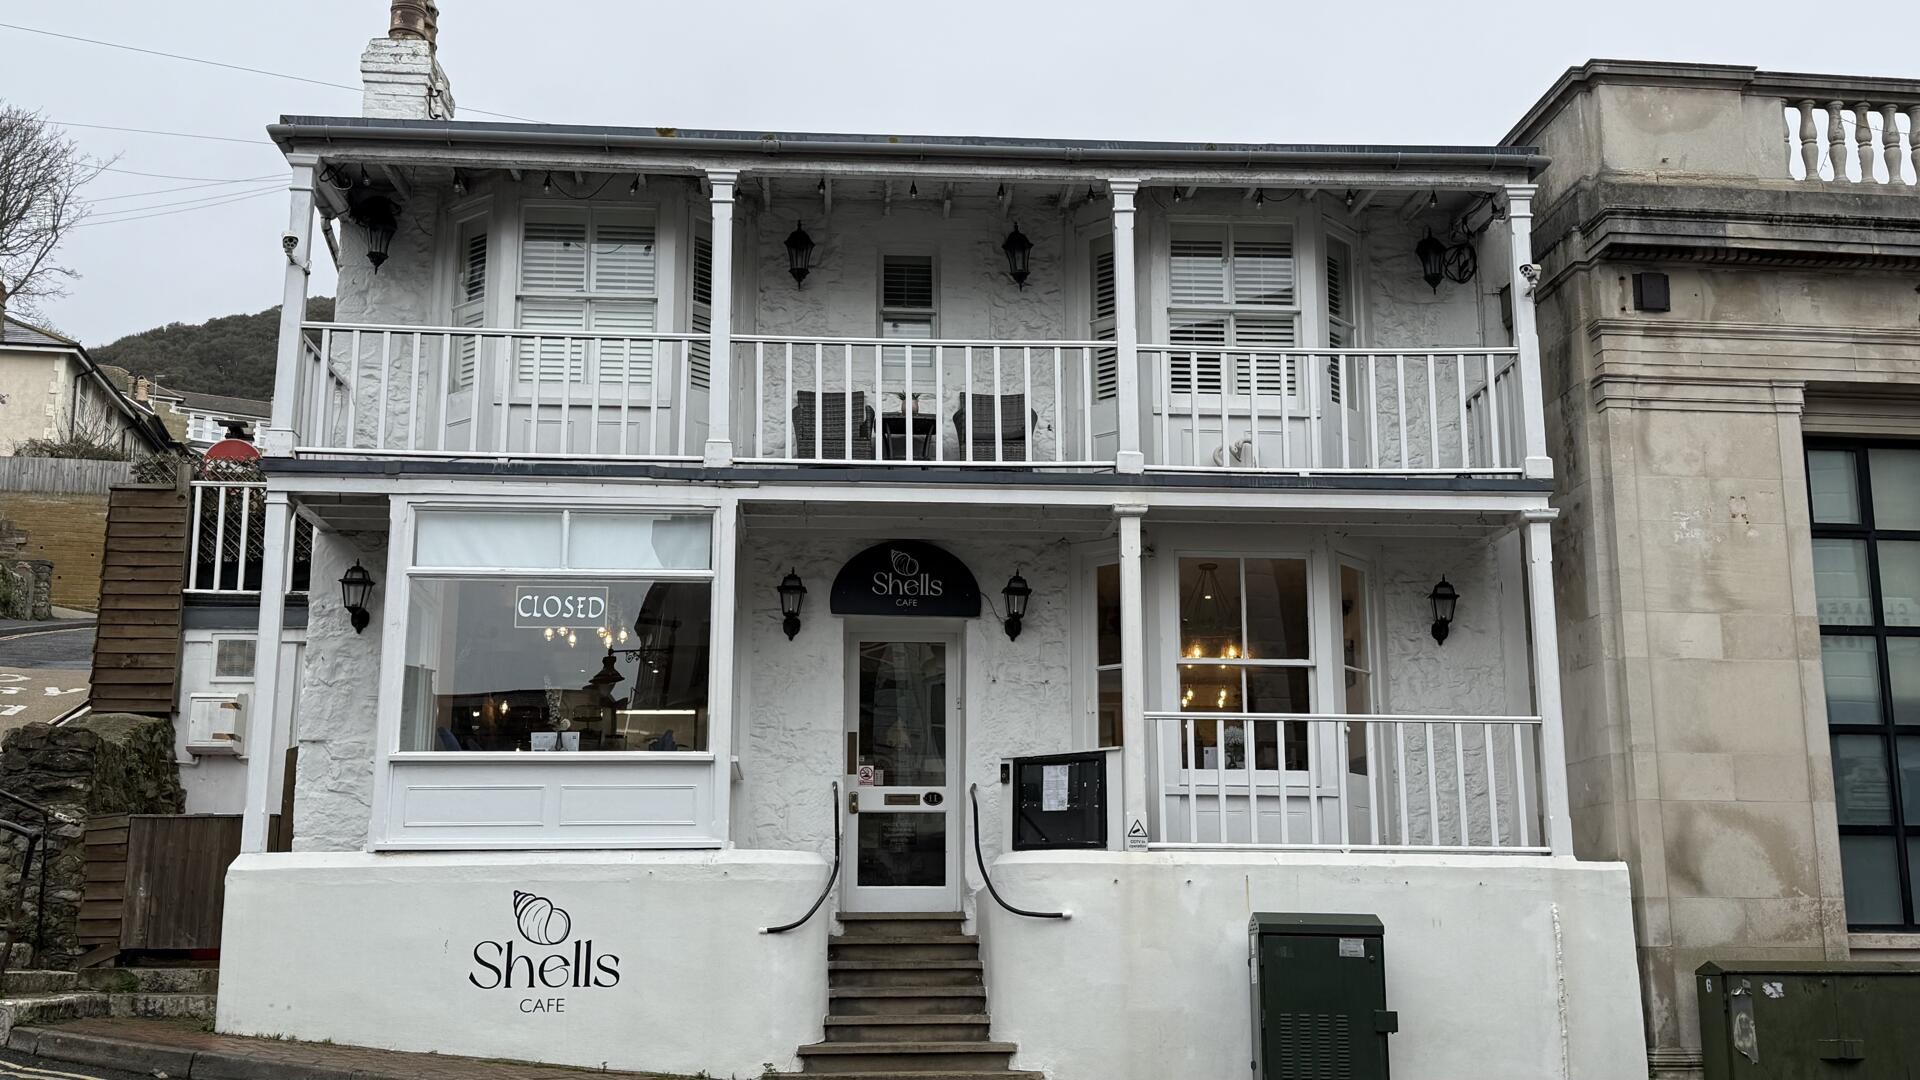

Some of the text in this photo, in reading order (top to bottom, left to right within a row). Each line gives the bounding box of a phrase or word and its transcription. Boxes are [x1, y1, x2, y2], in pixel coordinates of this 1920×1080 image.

[872, 571, 943, 597] Shells
[518, 595, 605, 618] CLOSED
[895, 599, 918, 607] CAFE
[468, 939, 620, 989] Shells
[1705, 978, 1712, 993] 6
[519, 998, 566, 1013] CAFE
